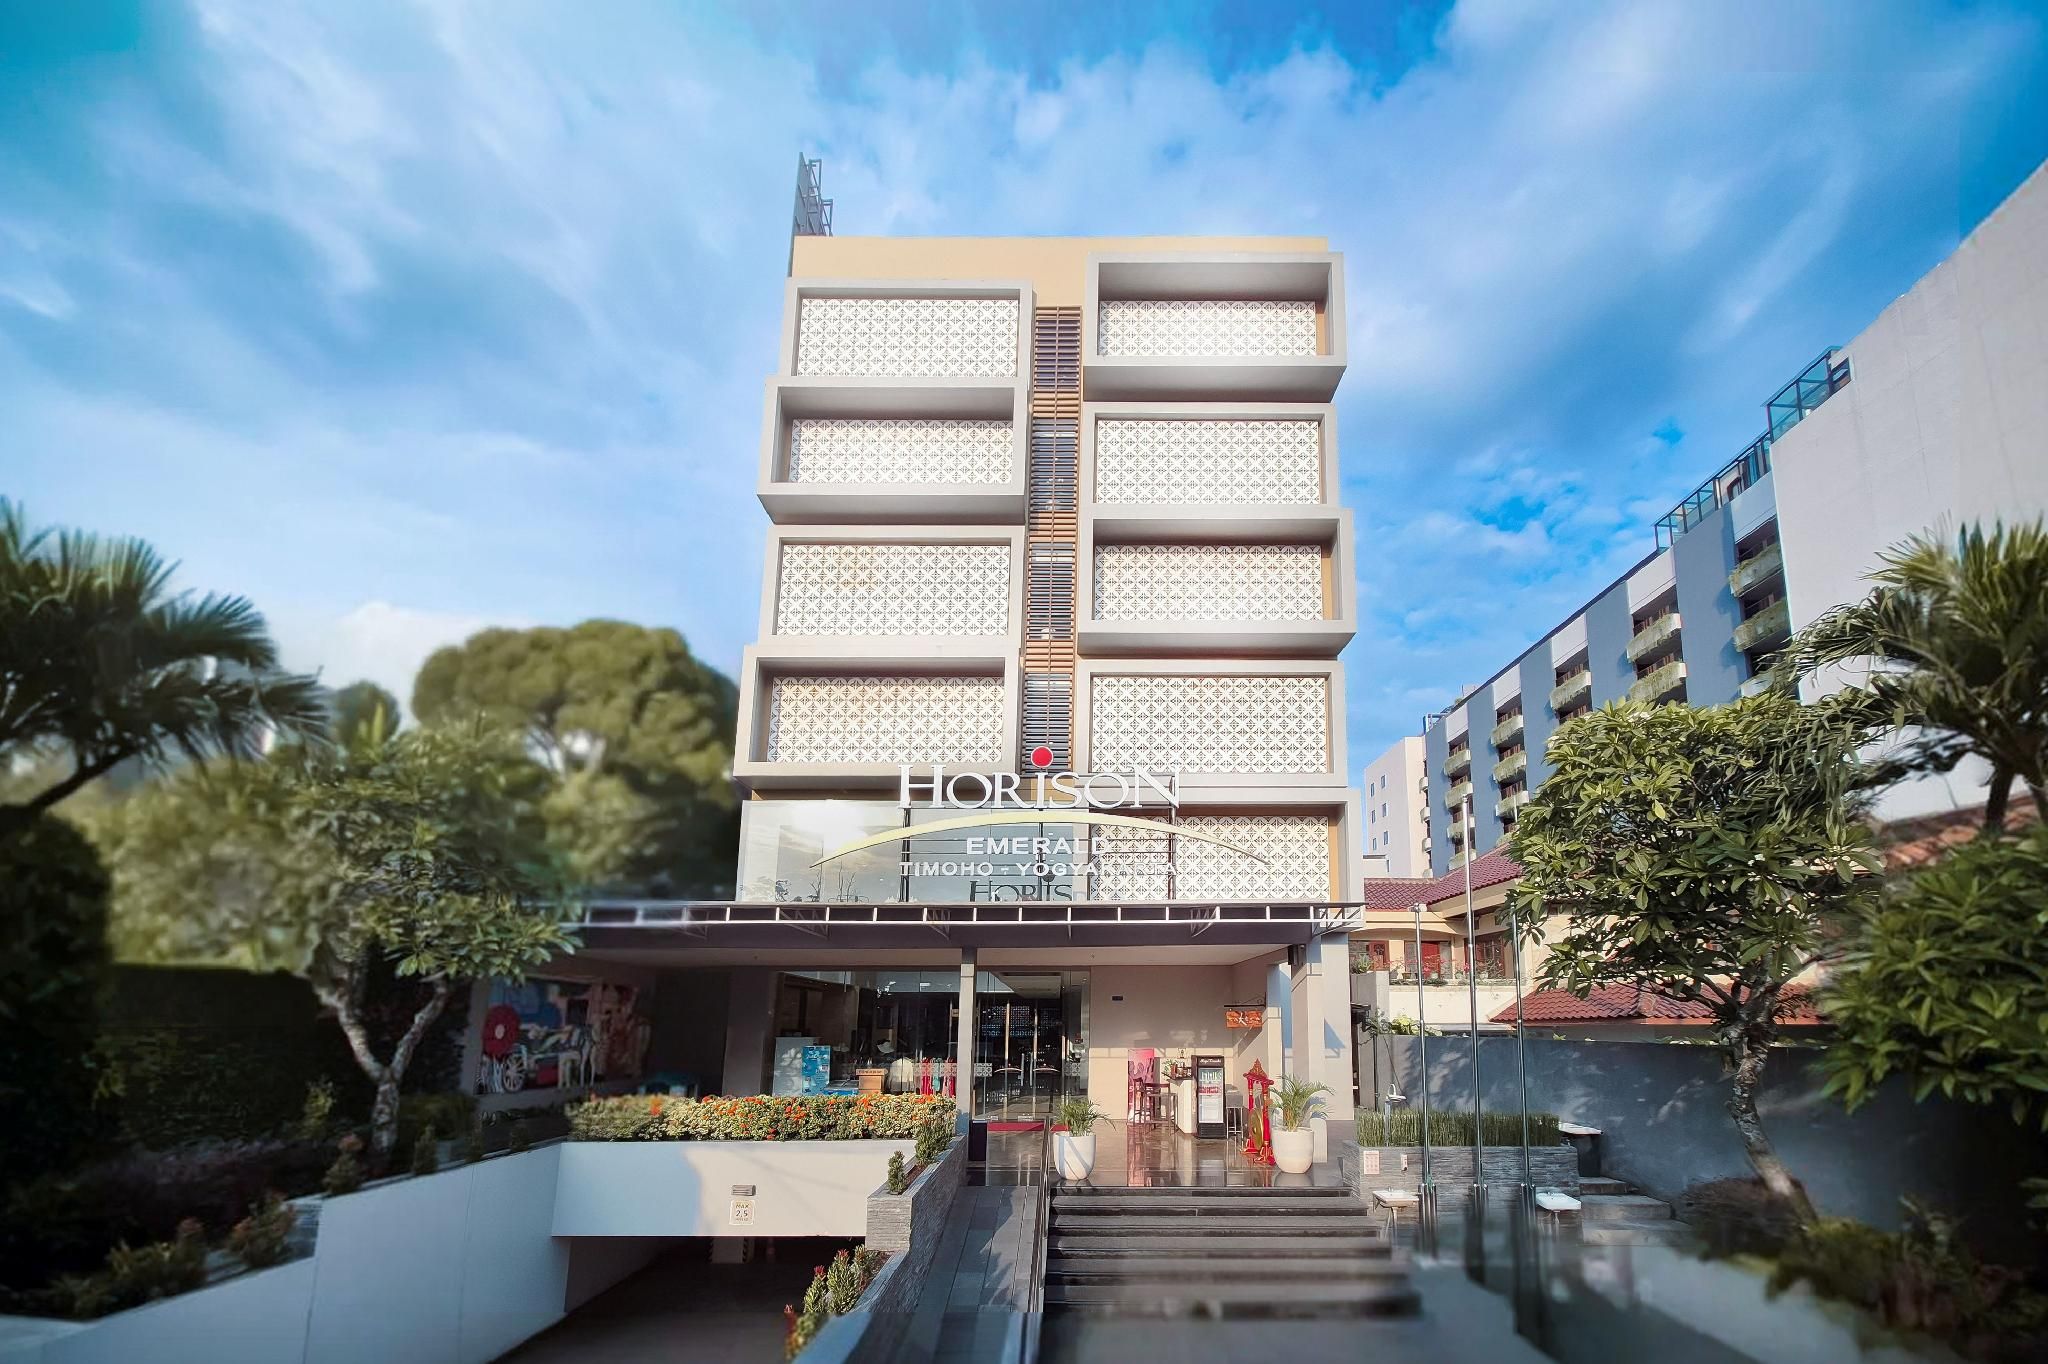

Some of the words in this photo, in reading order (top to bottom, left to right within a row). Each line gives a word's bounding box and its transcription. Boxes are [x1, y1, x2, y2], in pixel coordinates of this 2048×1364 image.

[899, 764, 1180, 809] HORISON
[966, 837, 1110, 855] EMERALD
[899, 861, 994, 877] TIMOHO
